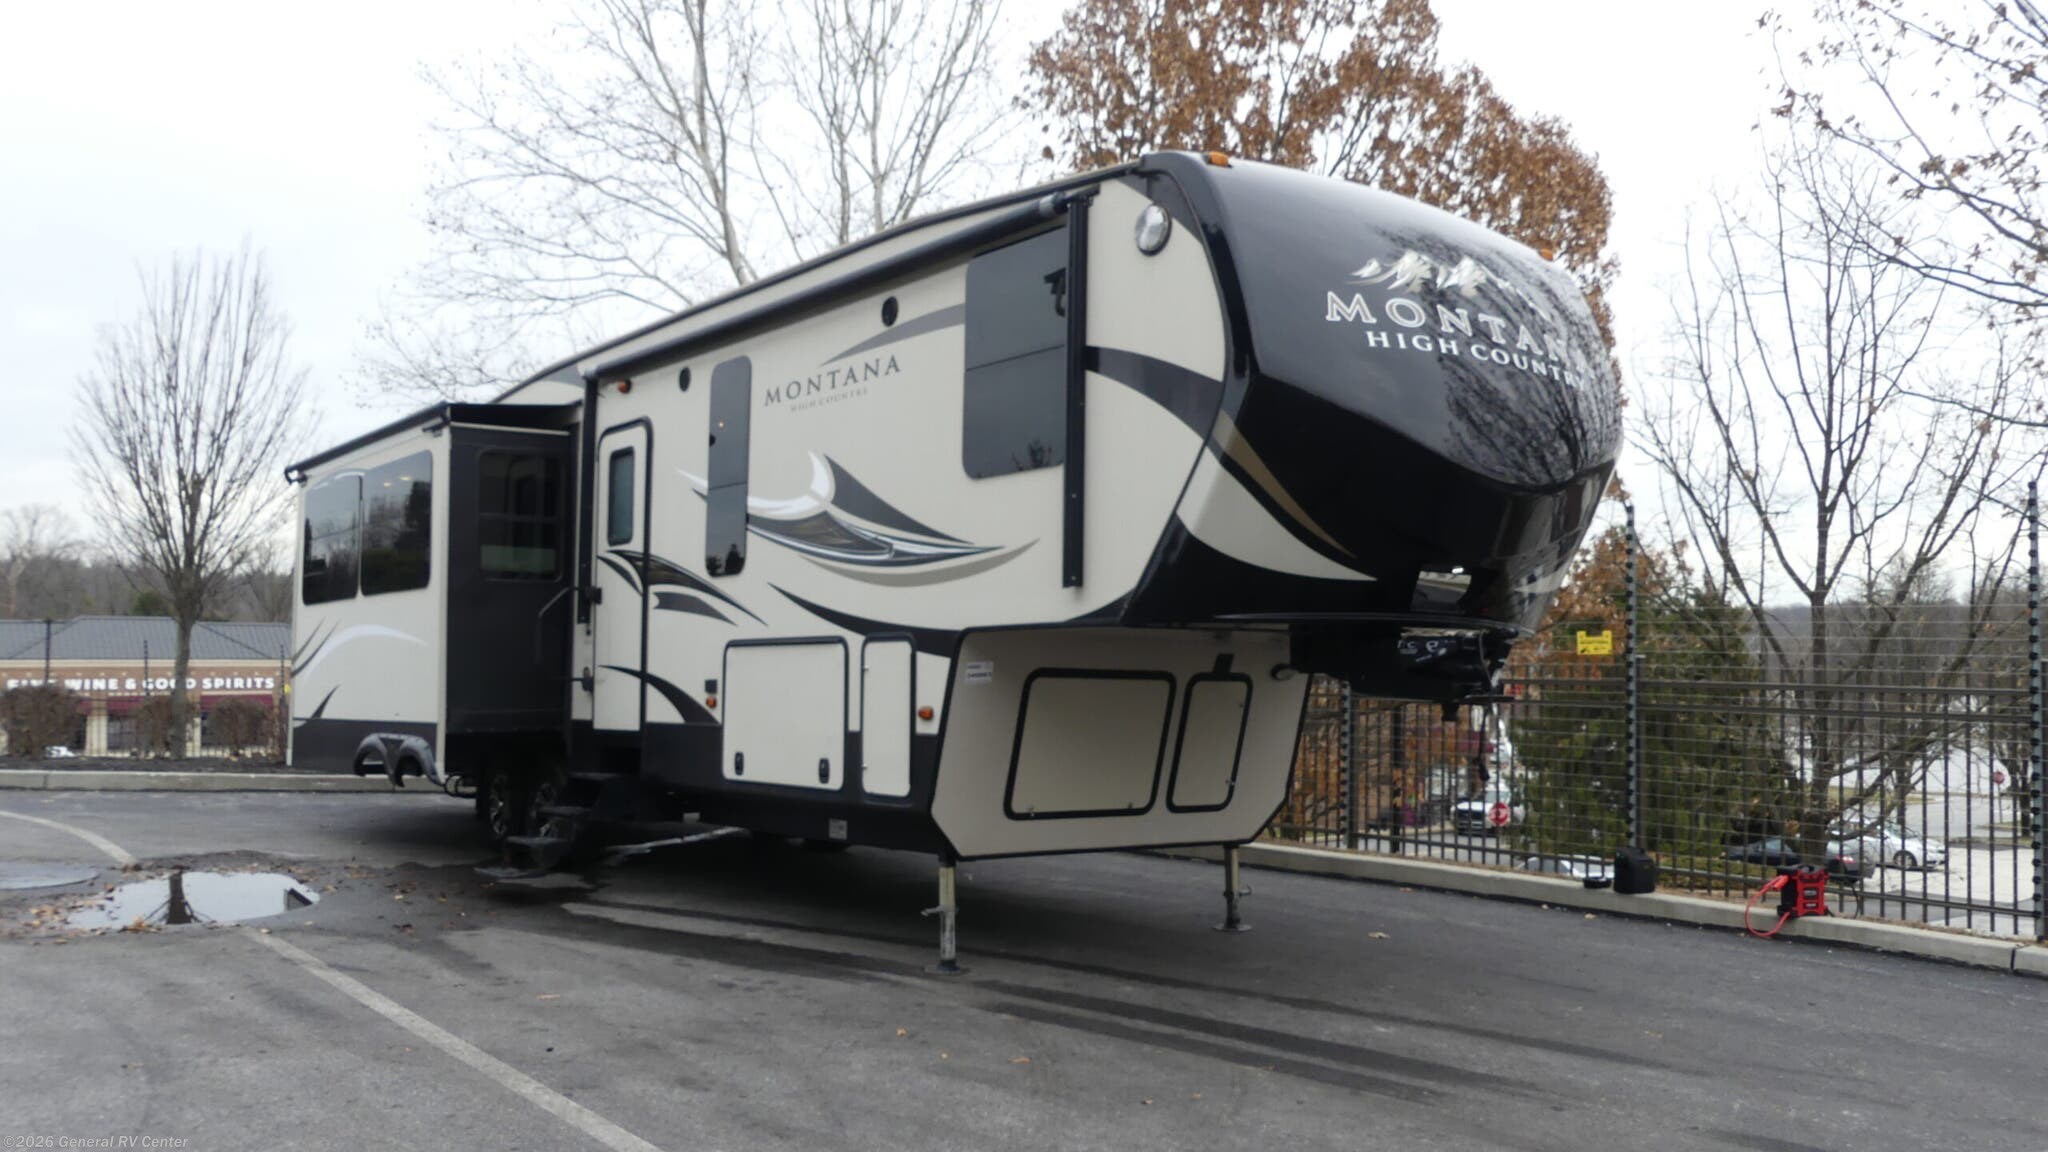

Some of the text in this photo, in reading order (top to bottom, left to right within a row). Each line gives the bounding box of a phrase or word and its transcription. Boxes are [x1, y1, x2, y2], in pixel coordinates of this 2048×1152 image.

[764, 354, 901, 407] MONTANA
[1366, 331, 1585, 391] HIGH COUNTRY
[64, 678, 118, 690] WINE
[202, 677, 275, 690] SPIRITS
